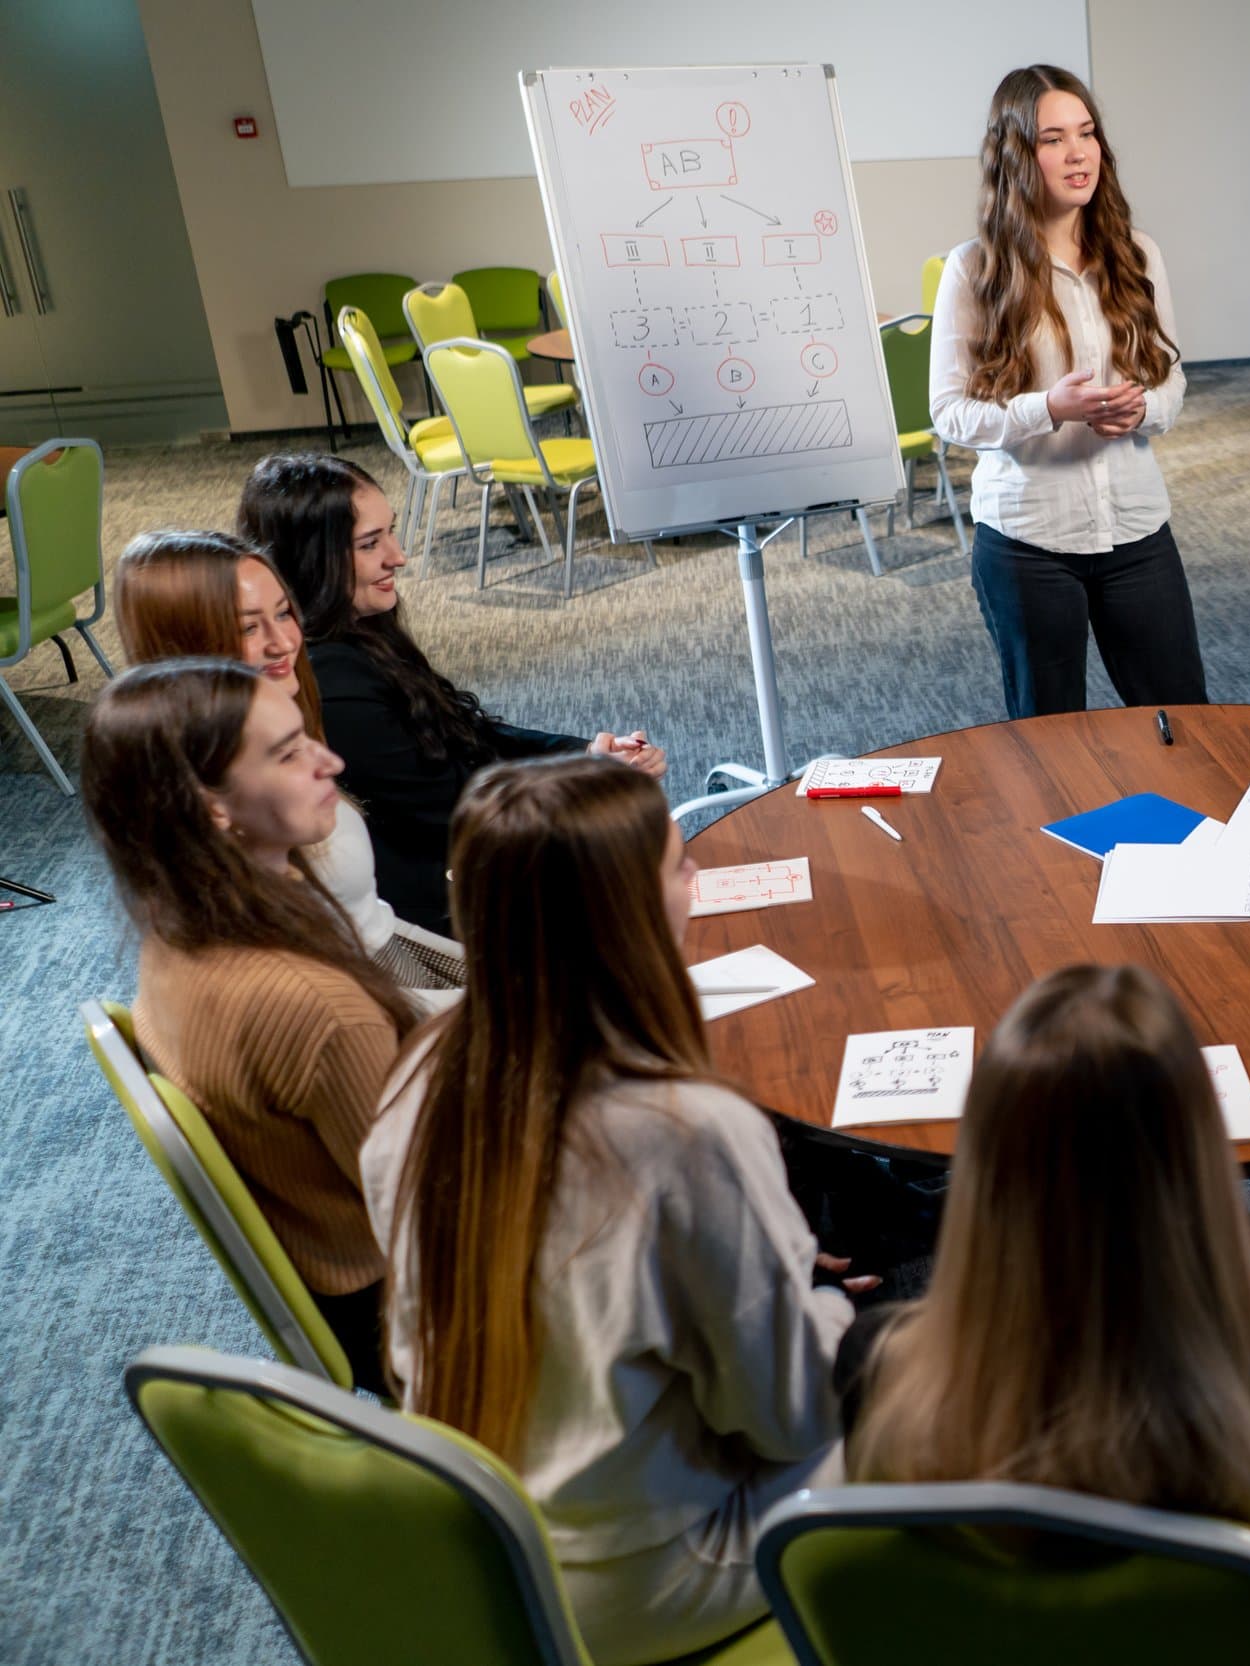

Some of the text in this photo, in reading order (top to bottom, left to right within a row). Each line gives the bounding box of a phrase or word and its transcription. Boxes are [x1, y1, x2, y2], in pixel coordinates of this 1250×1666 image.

[569, 84, 611, 127] PLAN
[661, 149, 702, 177] AB
[632, 315, 650, 342] 3
[714, 310, 733, 336] 2
[799, 303, 817, 327] 1
[811, 352, 825, 370] C
[651, 373, 660, 387] A
[729, 369, 743, 384] B
